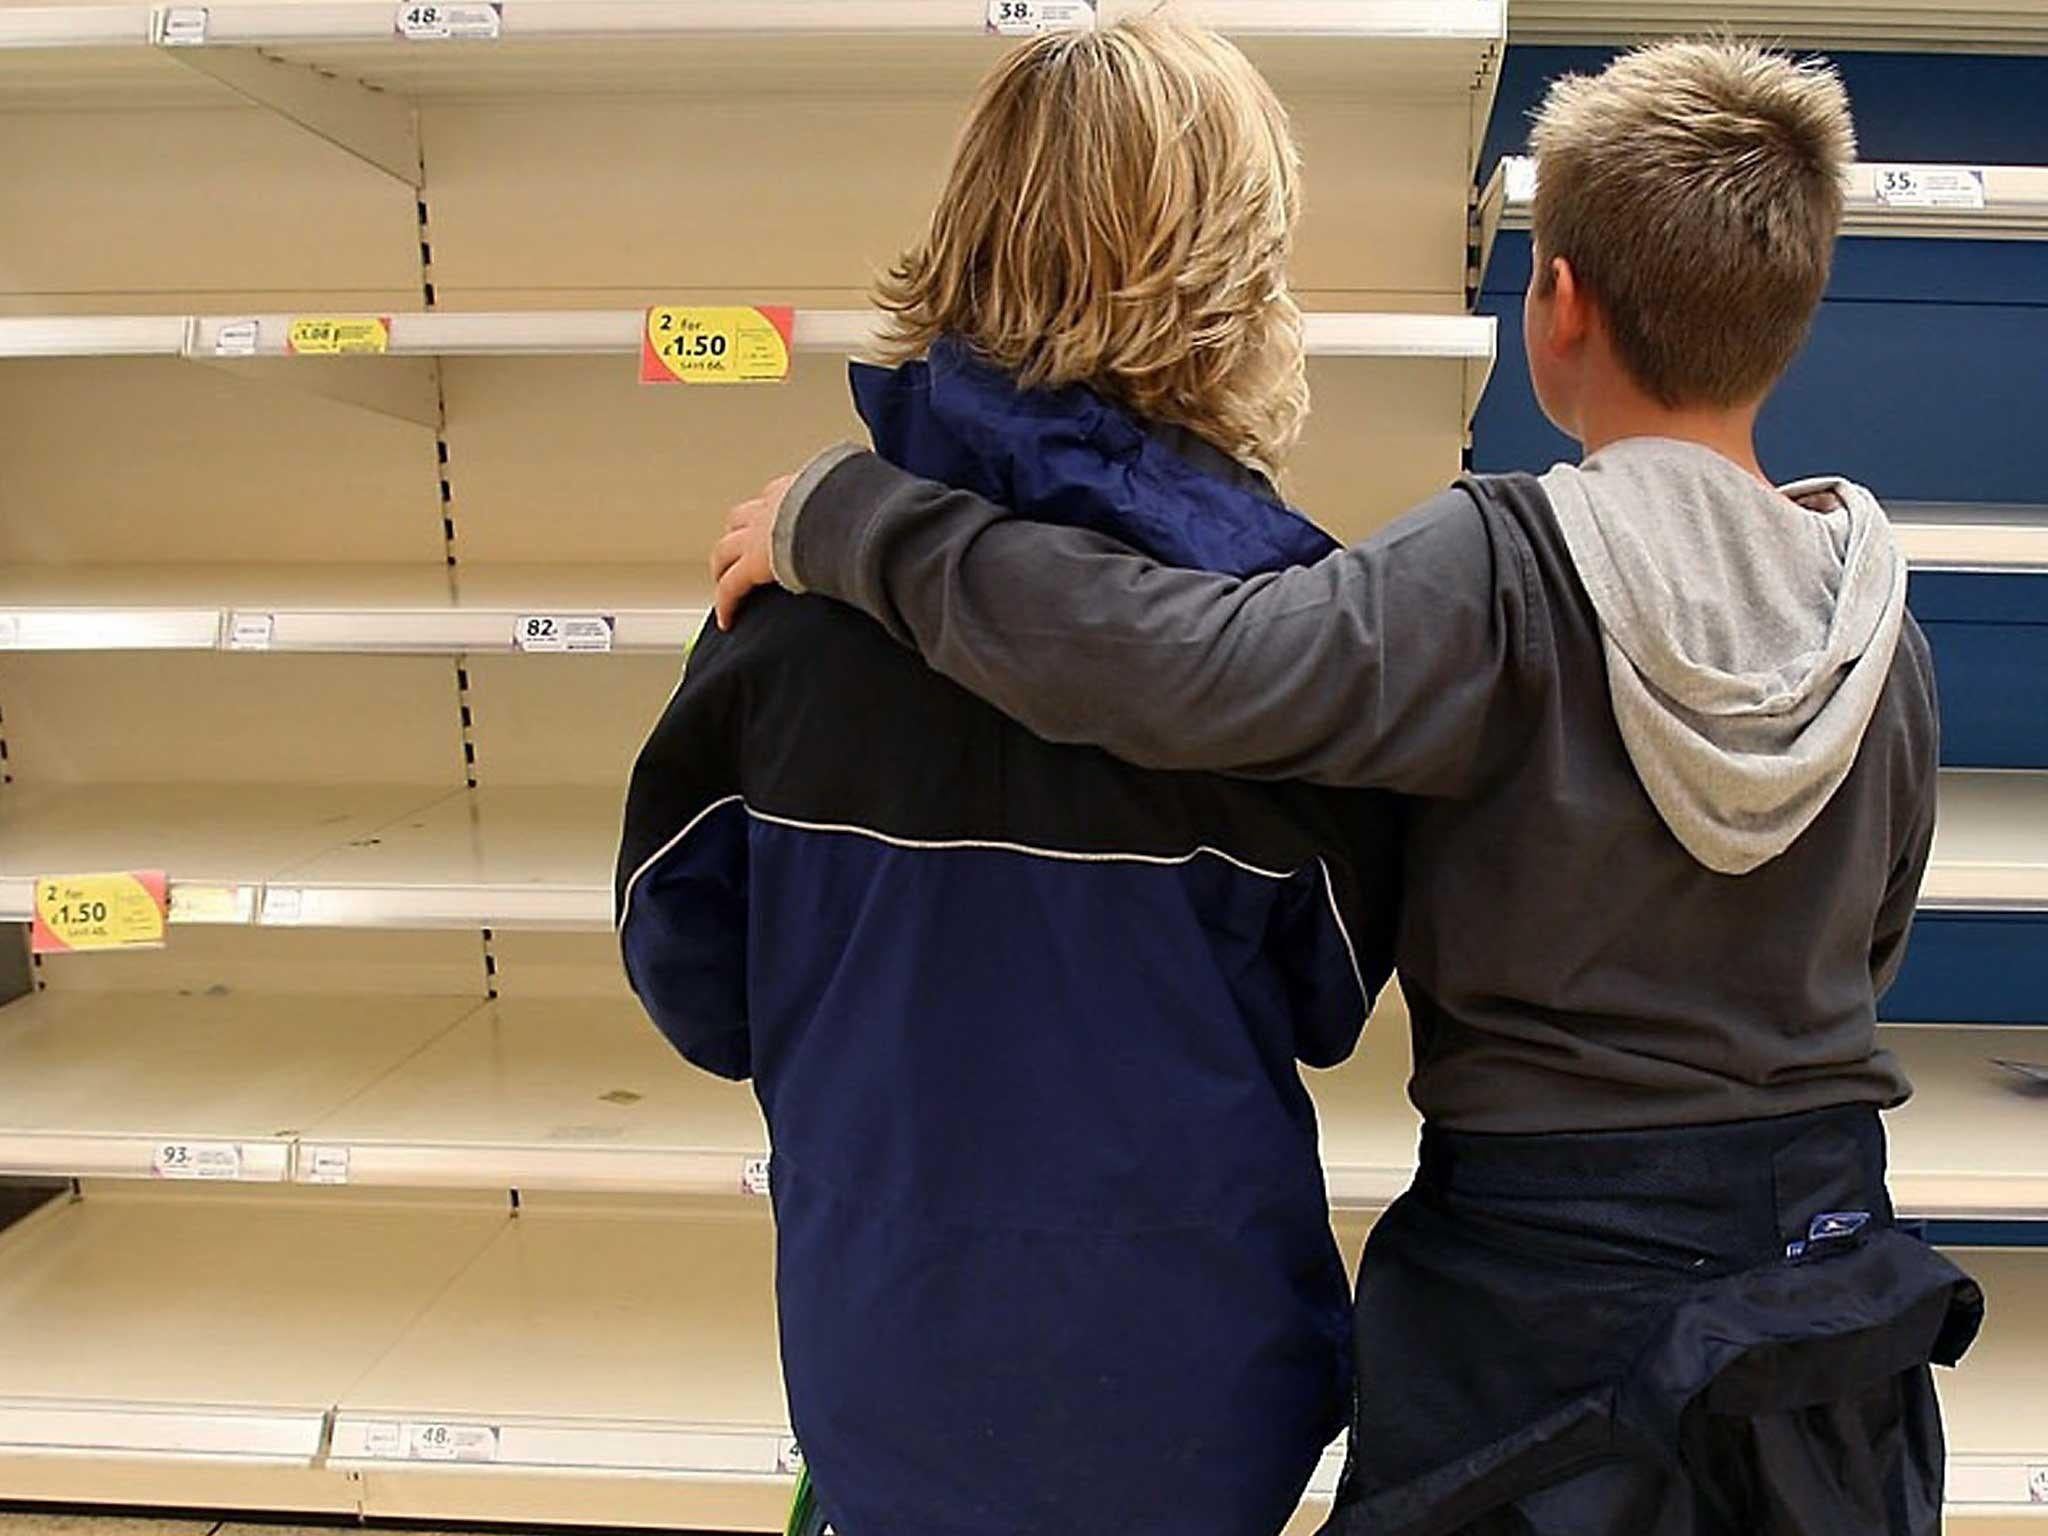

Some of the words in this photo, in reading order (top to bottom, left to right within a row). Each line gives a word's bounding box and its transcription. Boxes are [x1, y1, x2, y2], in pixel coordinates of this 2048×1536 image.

[659, 314, 673, 331] 2
[663, 335, 727, 356] £1.50
[47, 885, 57, 901] 2
[51, 902, 107, 924] £1.50
